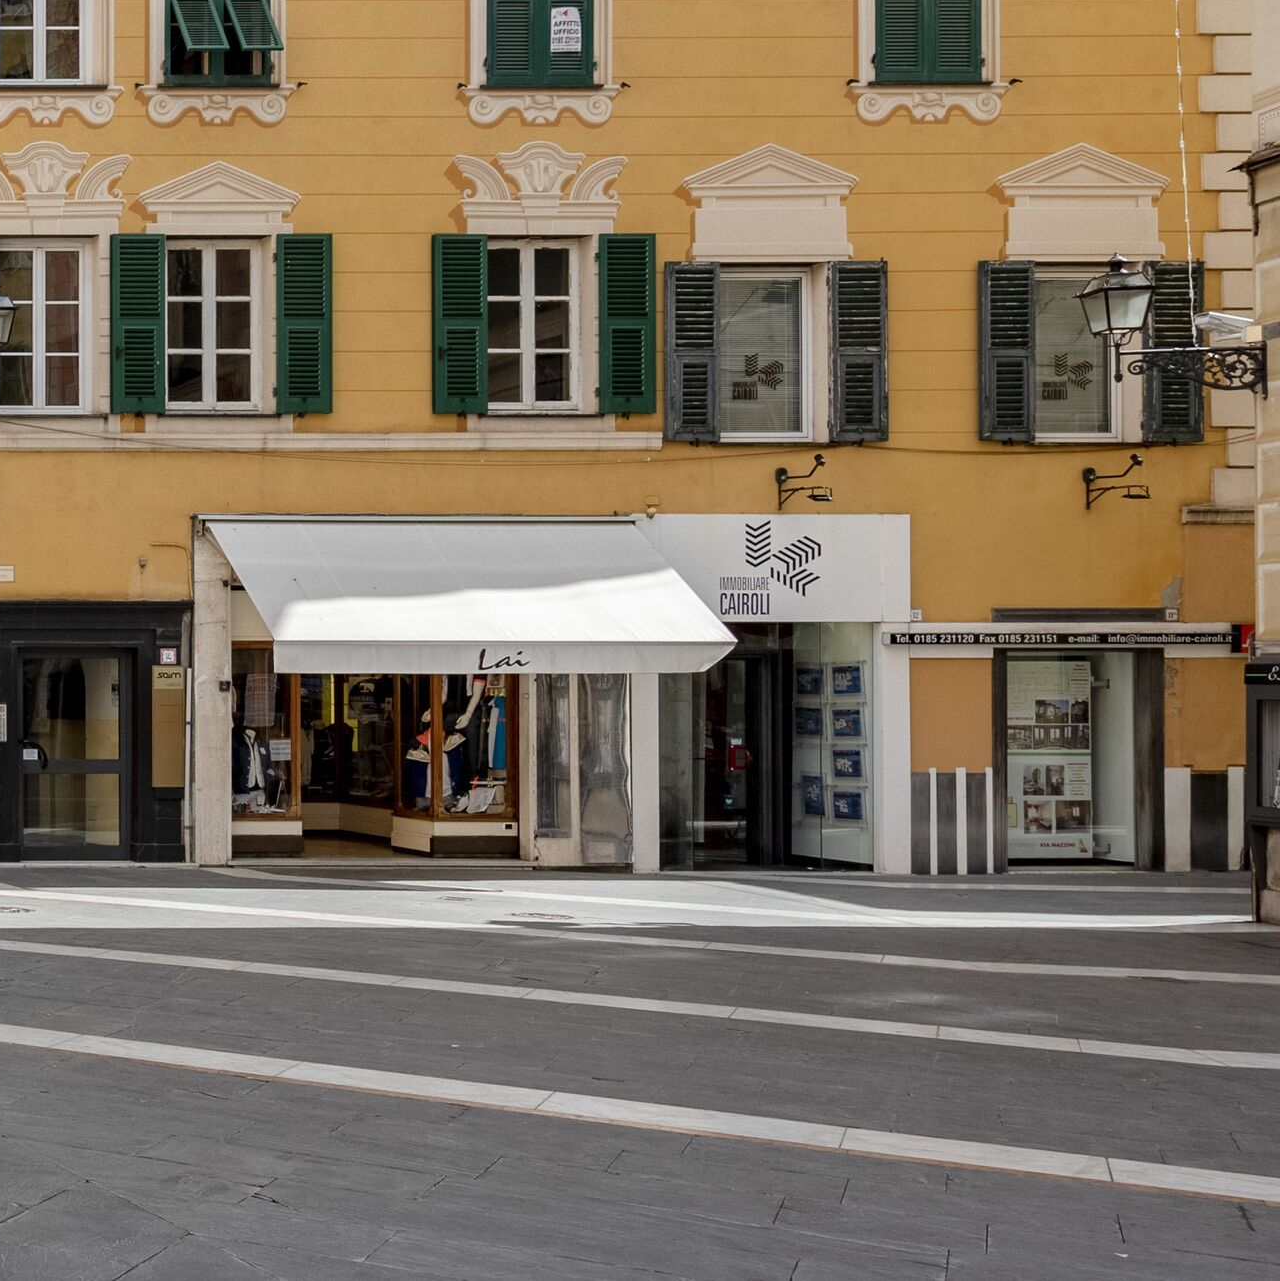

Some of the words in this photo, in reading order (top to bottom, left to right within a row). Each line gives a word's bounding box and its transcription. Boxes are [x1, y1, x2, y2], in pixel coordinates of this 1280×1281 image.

[553, 28, 579, 36] UFFICIO
[719, 576, 770, 591] IMMOBILIARE
[719, 592, 770, 616] CAIROLI
[895, 634, 911, 644] Tel.
[914, 634, 937, 644] 0185
[940, 634, 974, 644] 231120
[979, 634, 996, 644] Fax
[998, 634, 1021, 644] 0185
[1024, 634, 1057, 644] 231151
[1068, 634, 1100, 644] e-mail:
[1107, 633, 1233, 645] info@immobiliare-cairoli.it
[478, 648, 531, 671] Lai
